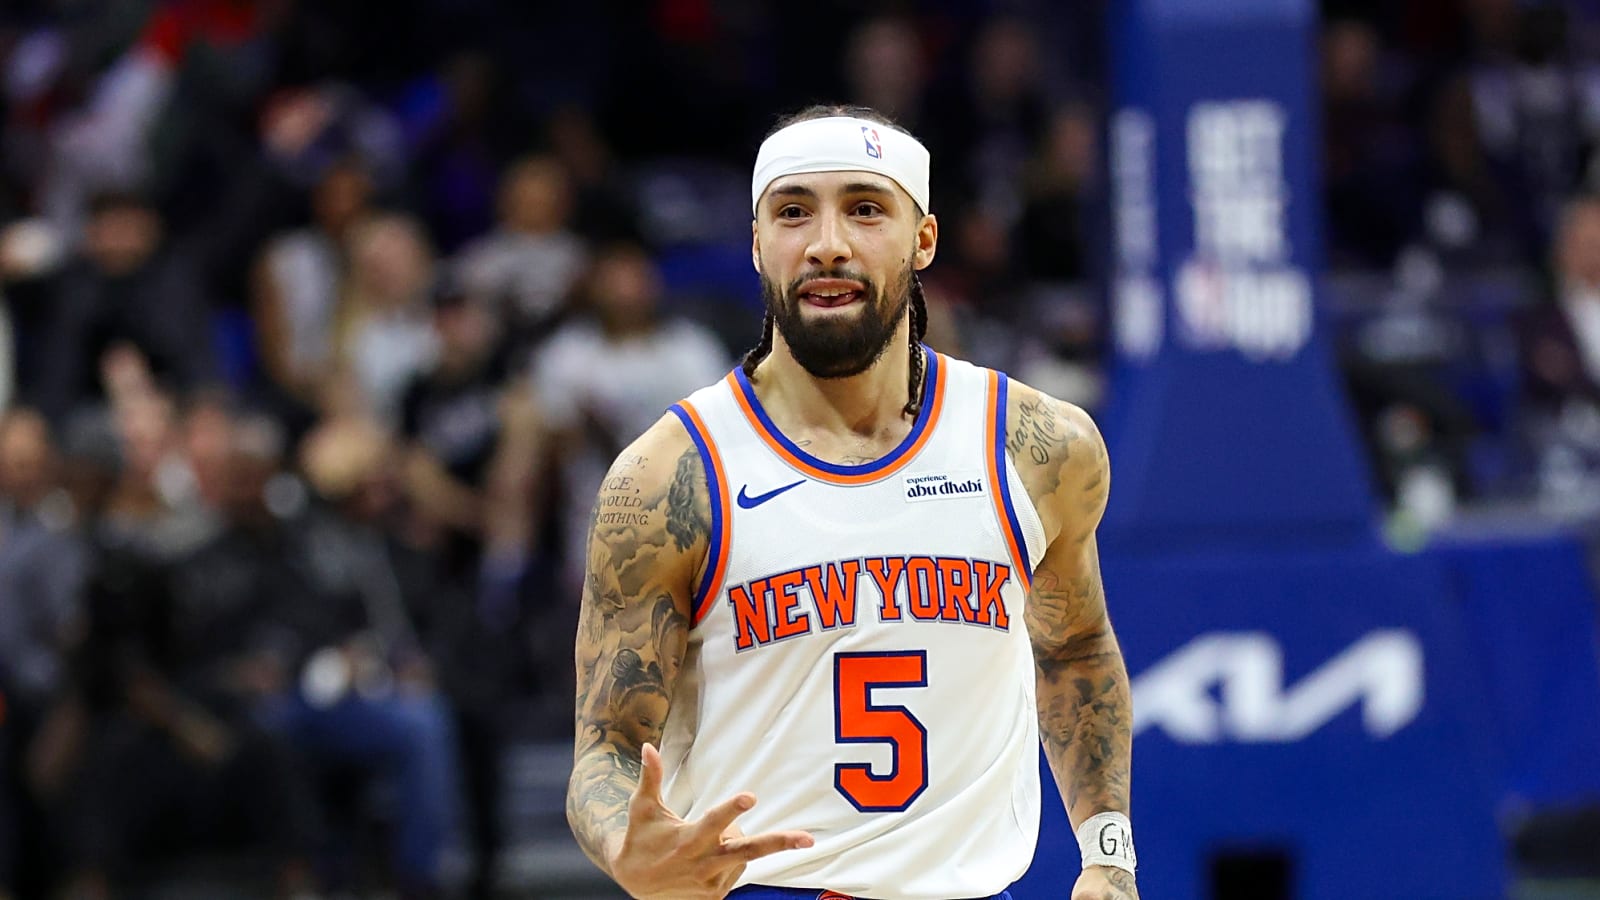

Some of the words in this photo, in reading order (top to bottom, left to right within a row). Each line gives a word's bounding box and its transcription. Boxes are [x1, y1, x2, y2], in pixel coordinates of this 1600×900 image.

[906, 474, 948, 484] experience
[907, 484, 938, 498] abu
[938, 478, 983, 495] dhabi
[727, 555, 864, 654] NEW
[864, 555, 1011, 634] YORK
[834, 649, 929, 813] 5
